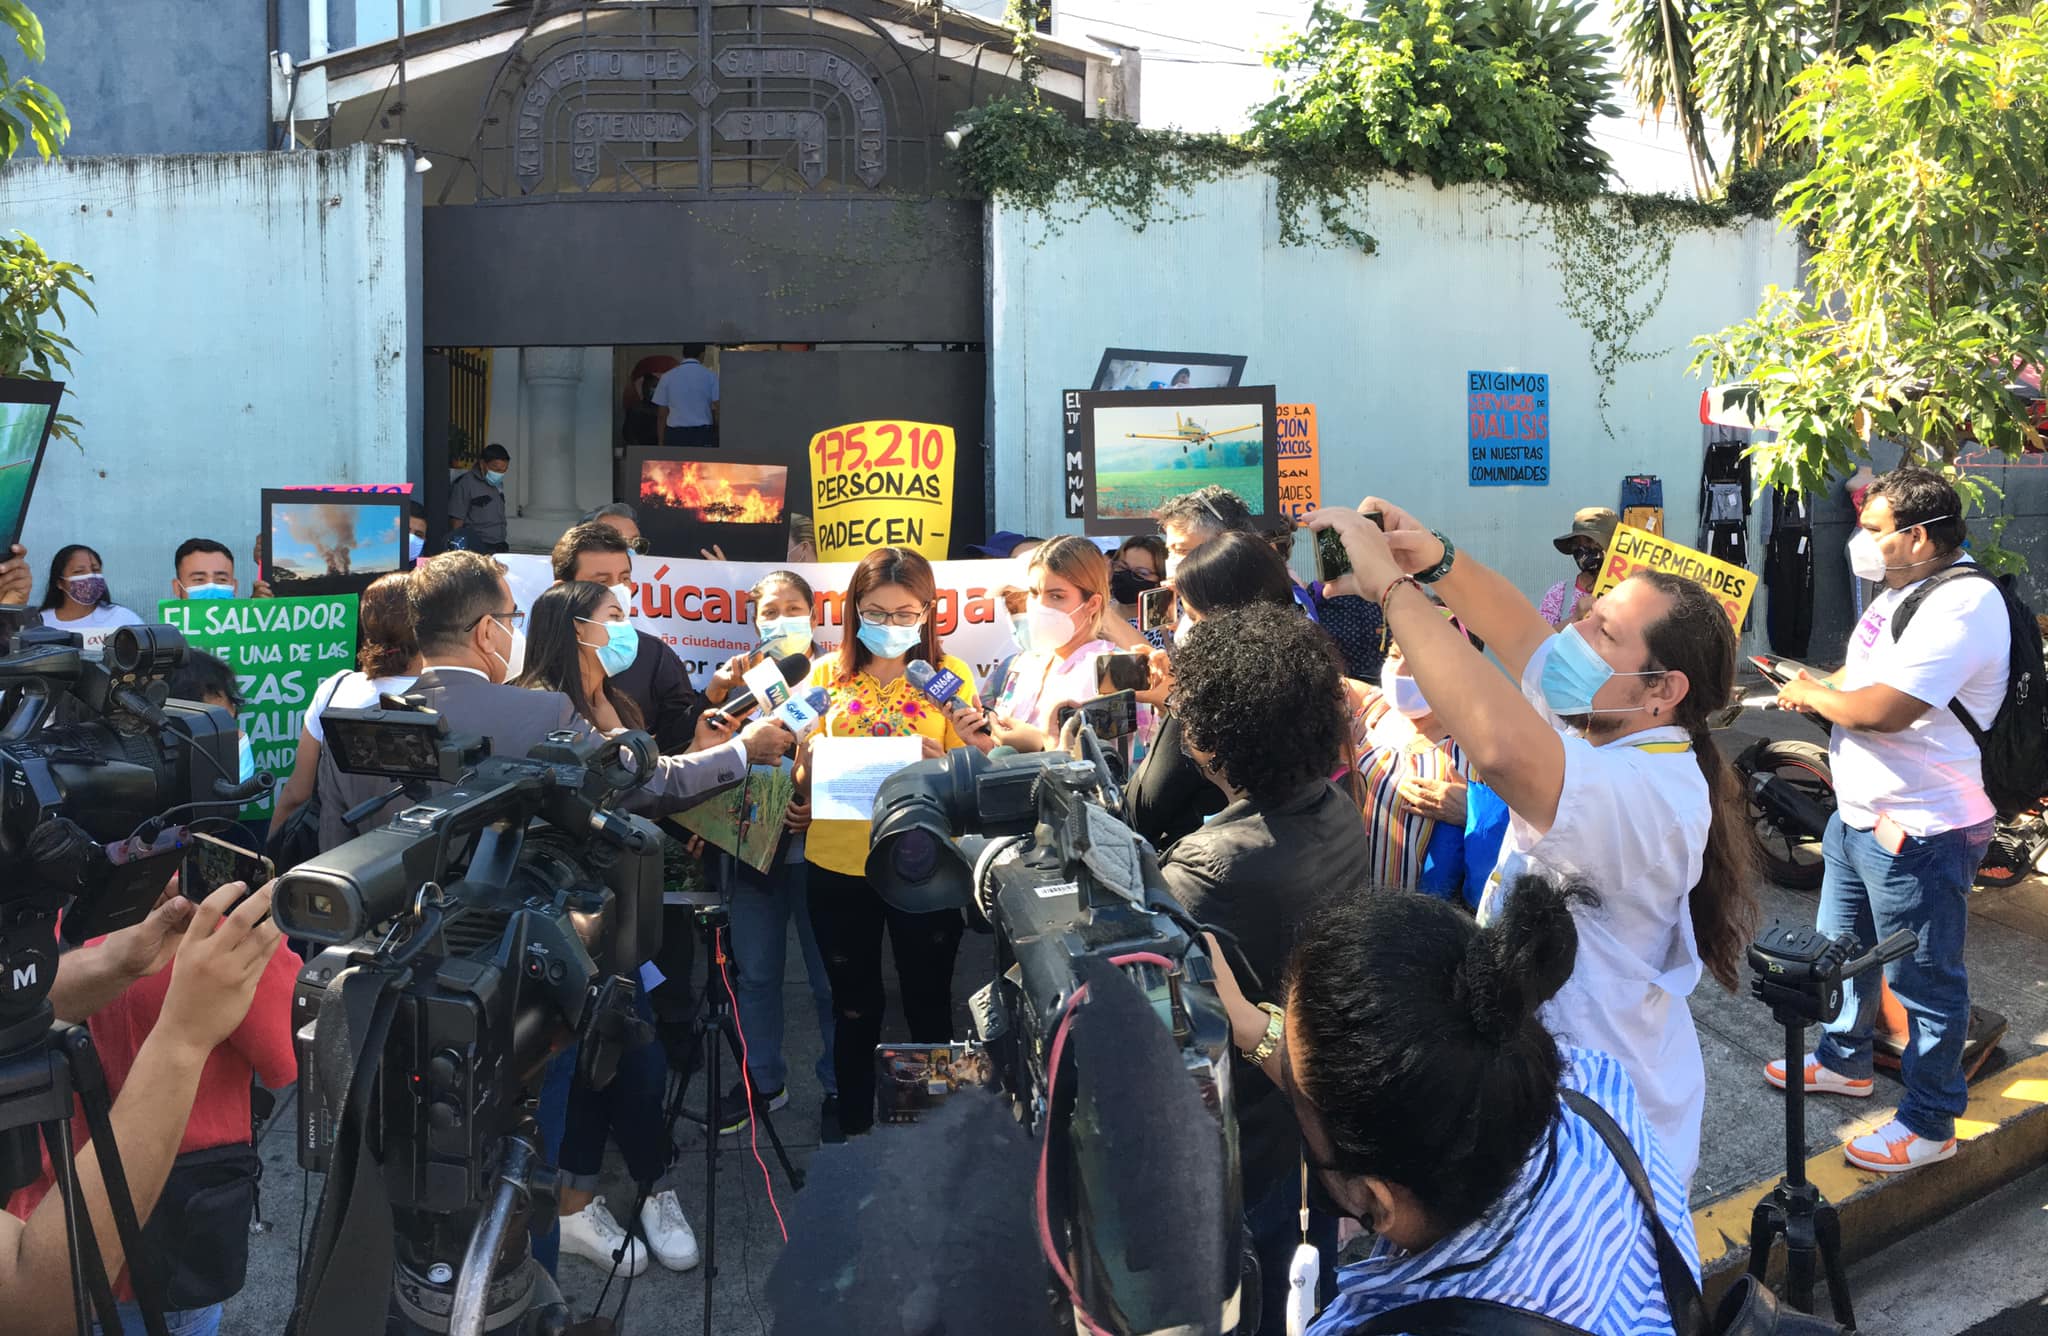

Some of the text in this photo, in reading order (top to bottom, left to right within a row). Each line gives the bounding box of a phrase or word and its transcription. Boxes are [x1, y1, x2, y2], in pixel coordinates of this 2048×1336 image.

[518, 50, 882, 177] MINISTERIO DE SALUD PUBLICA
[574, 112, 682, 174] ASISTENCIA
[1470, 373, 1545, 393] EXIGIMOS
[1294, 406, 1311, 416] LA
[1537, 400, 1545, 408] DE
[1470, 413, 1548, 440] DIALISIS
[815, 424, 943, 475] 175,210
[1472, 446, 1544, 461] EN NUESTRAS
[817, 472, 941, 504] PERSONAS
[1471, 466, 1548, 482] COMUNIDADES
[819, 516, 924, 552] PADECEN
[1615, 531, 1746, 598] ENFERMEDADES
[164, 602, 346, 636] EL SALVADOR
[239, 643, 283, 666] UNA
[289, 643, 313, 663] DE
[317, 640, 350, 660] LAS
[681, 634, 750, 652] ciudadana
[308, 1117, 316, 1149] SONY
